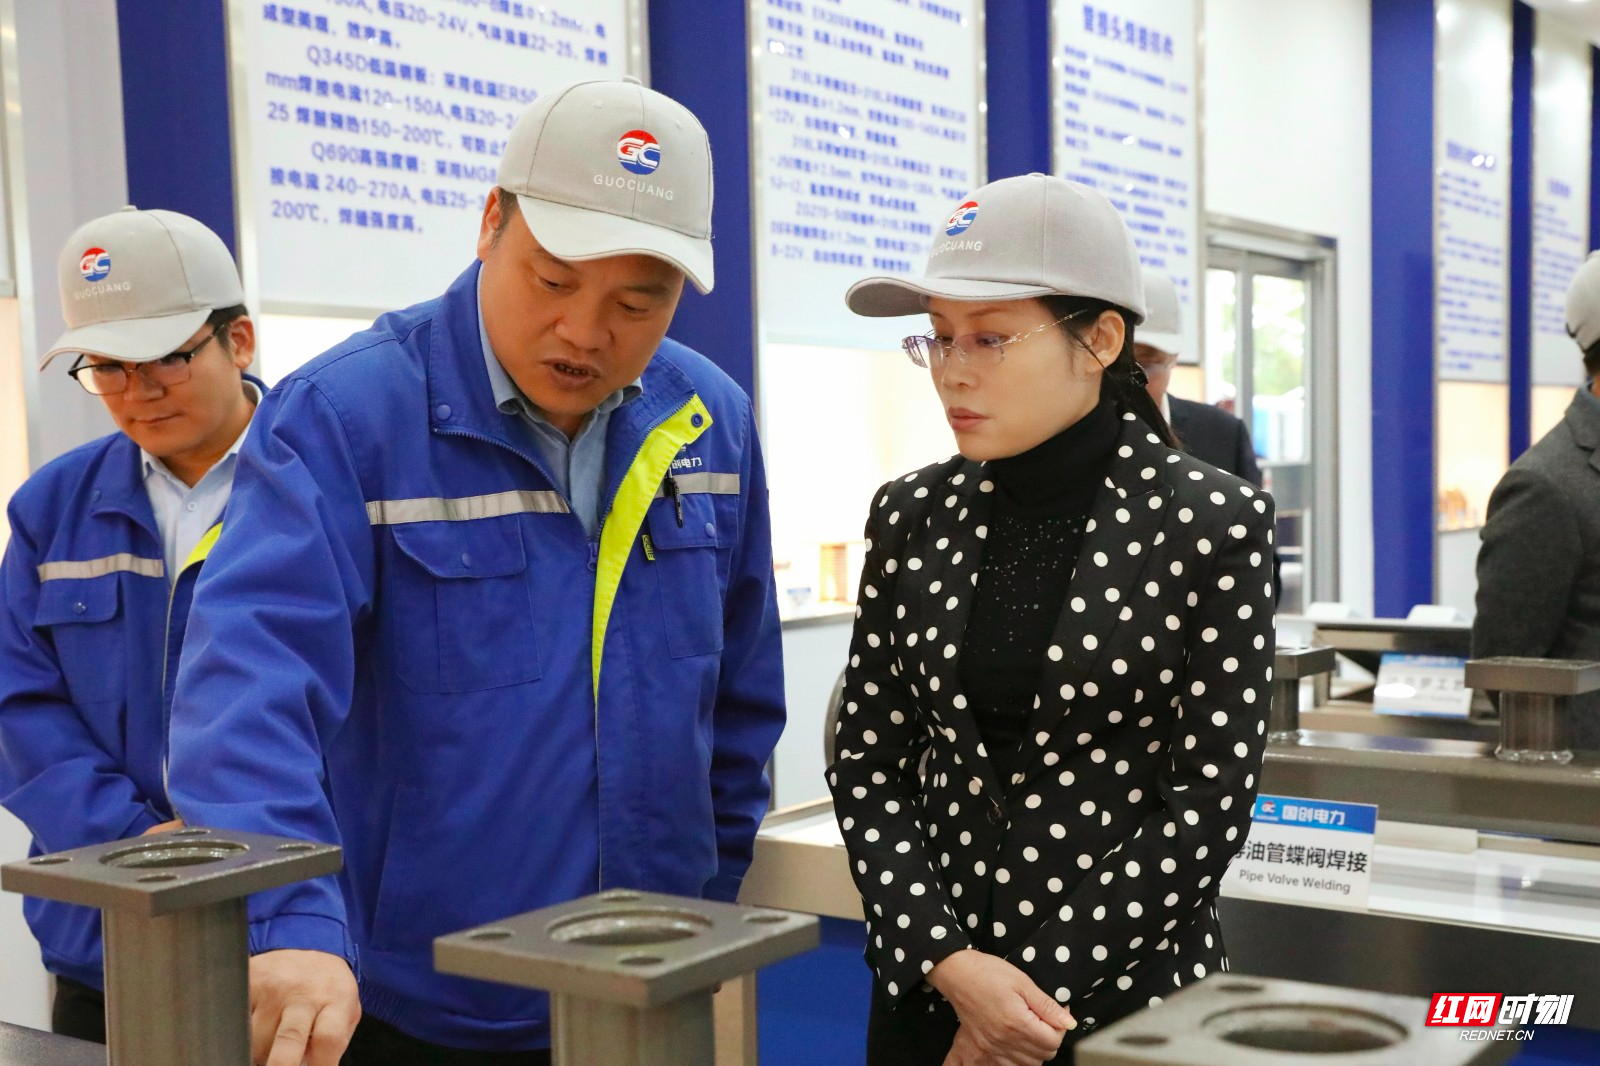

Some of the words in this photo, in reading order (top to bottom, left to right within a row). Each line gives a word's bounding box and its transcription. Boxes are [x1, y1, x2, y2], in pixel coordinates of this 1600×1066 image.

[593, 174, 674, 201] GUOCUANG
[1282, 804, 1346, 826] 国创电力
[1239, 869, 1264, 882] Pipe
[1267, 873, 1299, 886] Valve
[1302, 877, 1351, 895] Welding
